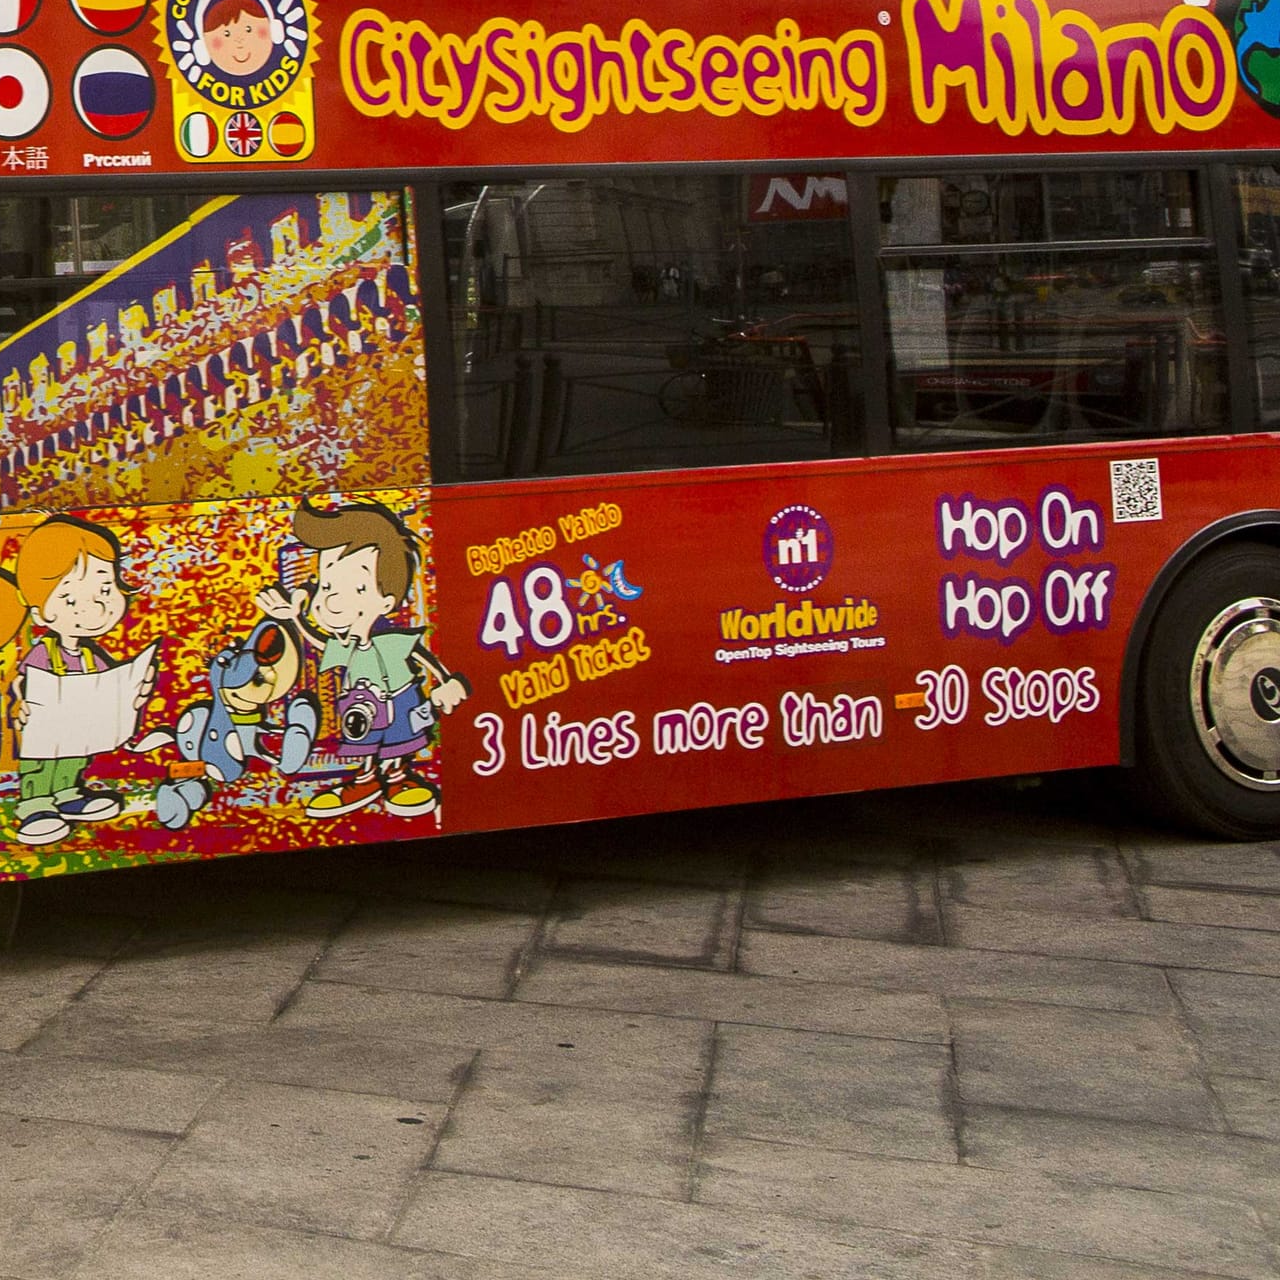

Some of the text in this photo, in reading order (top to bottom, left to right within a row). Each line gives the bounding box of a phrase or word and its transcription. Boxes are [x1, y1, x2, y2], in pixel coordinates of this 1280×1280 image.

[197, 55, 299, 106] FOR KIDS
[83, 151, 151, 168] Русский
[467, 503, 622, 576] Biglietto Valido
[770, 505, 822, 524] Operator
[941, 491, 1098, 559] Hop On
[481, 567, 573, 656] 48
[773, 575, 823, 592] Operador
[945, 569, 1111, 637] Hop Off
[720, 597, 879, 641] Worldwide
[500, 626, 651, 709] Valid Ticket
[715, 636, 886, 663] OpenTop Sightseeing Tours
[473, 664, 1100, 776] 3 Lines more than 30 Stops
